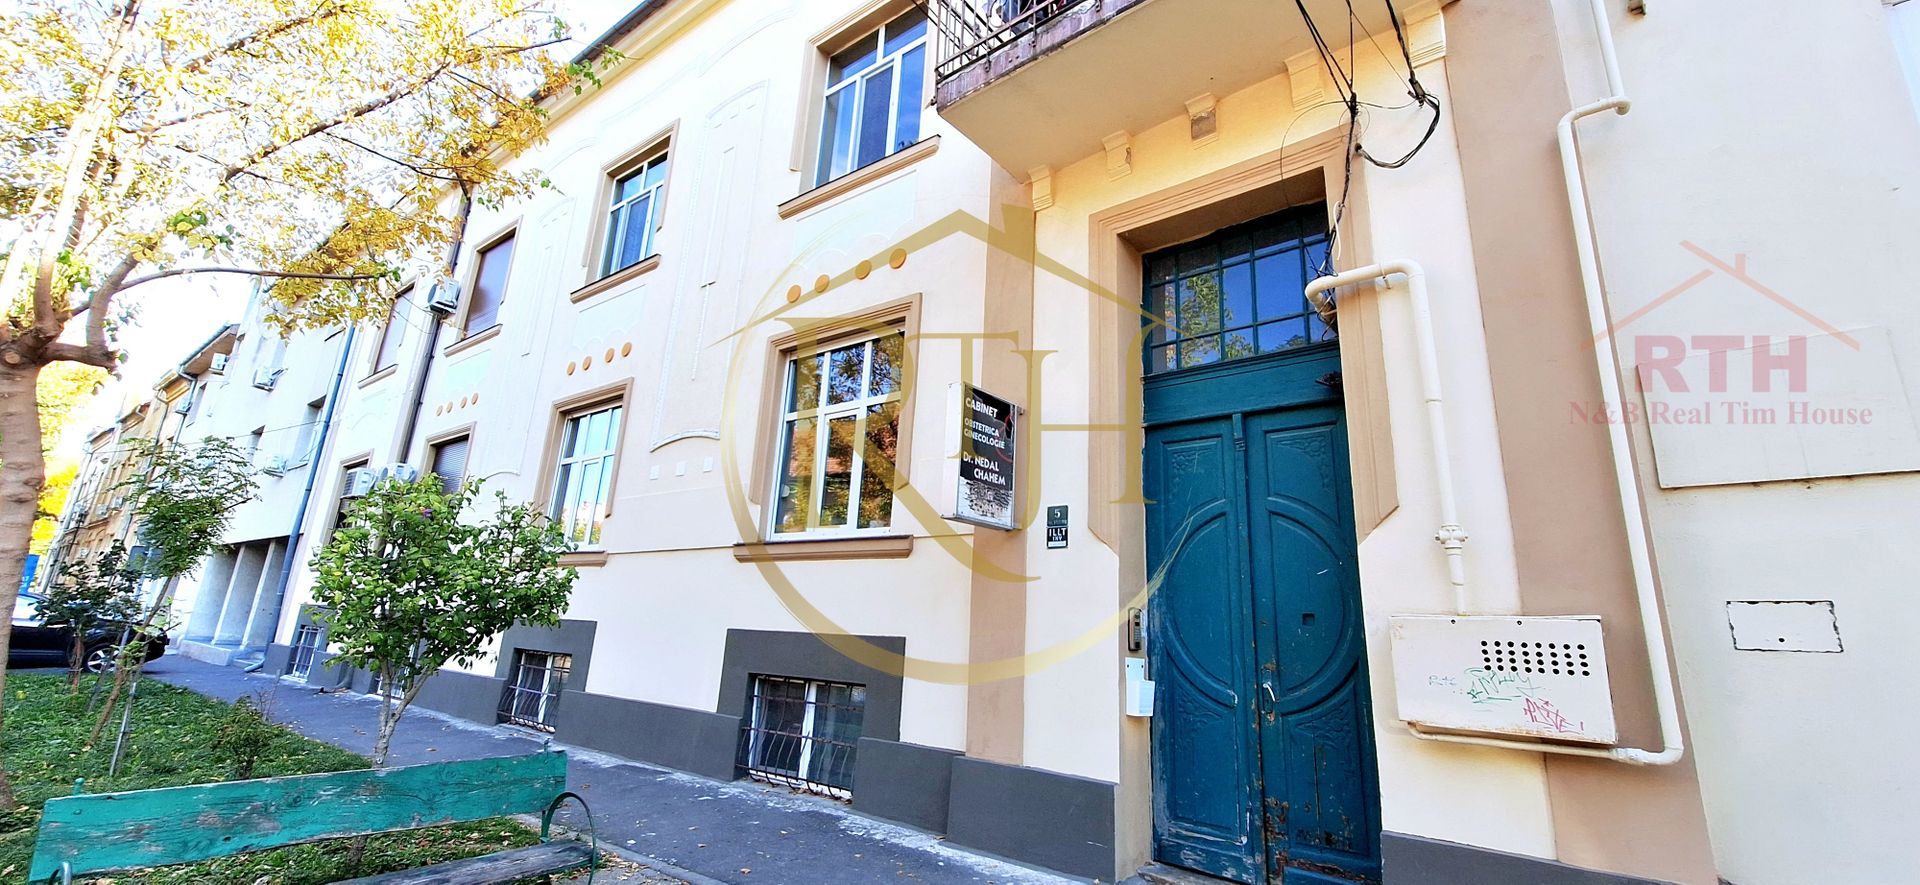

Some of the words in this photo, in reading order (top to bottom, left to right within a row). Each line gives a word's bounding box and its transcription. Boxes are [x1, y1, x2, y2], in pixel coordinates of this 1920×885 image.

[965, 397, 998, 418] CABINET
[964, 417, 1000, 437] OBSTETRICA
[963, 428, 1005, 449] GINECOLOGIE
[963, 451, 973, 464] Dr.
[974, 455, 999, 471] NEDAL
[973, 468, 1006, 486] CHAHEM
[1054, 508, 1061, 518] 5
